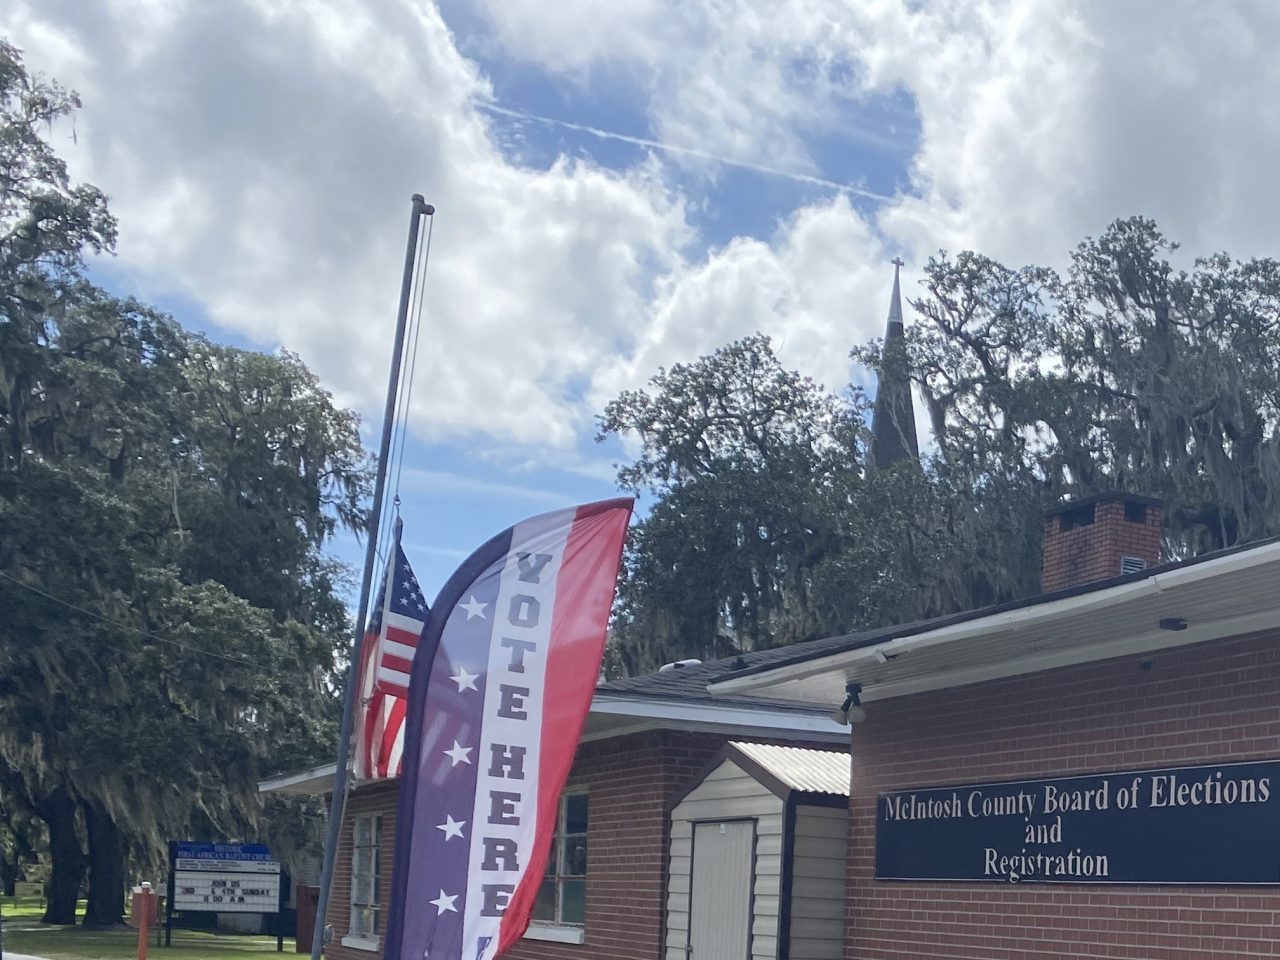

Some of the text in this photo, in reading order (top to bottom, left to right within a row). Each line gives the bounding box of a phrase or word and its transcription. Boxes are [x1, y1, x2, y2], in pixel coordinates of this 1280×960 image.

[480, 551, 553, 917] VOTE HERE
[884, 771, 1271, 821] McIntosh County Board of Elections
[1024, 815, 1062, 845] and
[984, 847, 1110, 884] Registration
[210, 880, 241, 888] JOIN US
[242, 889, 271, 897] SUNDAY
